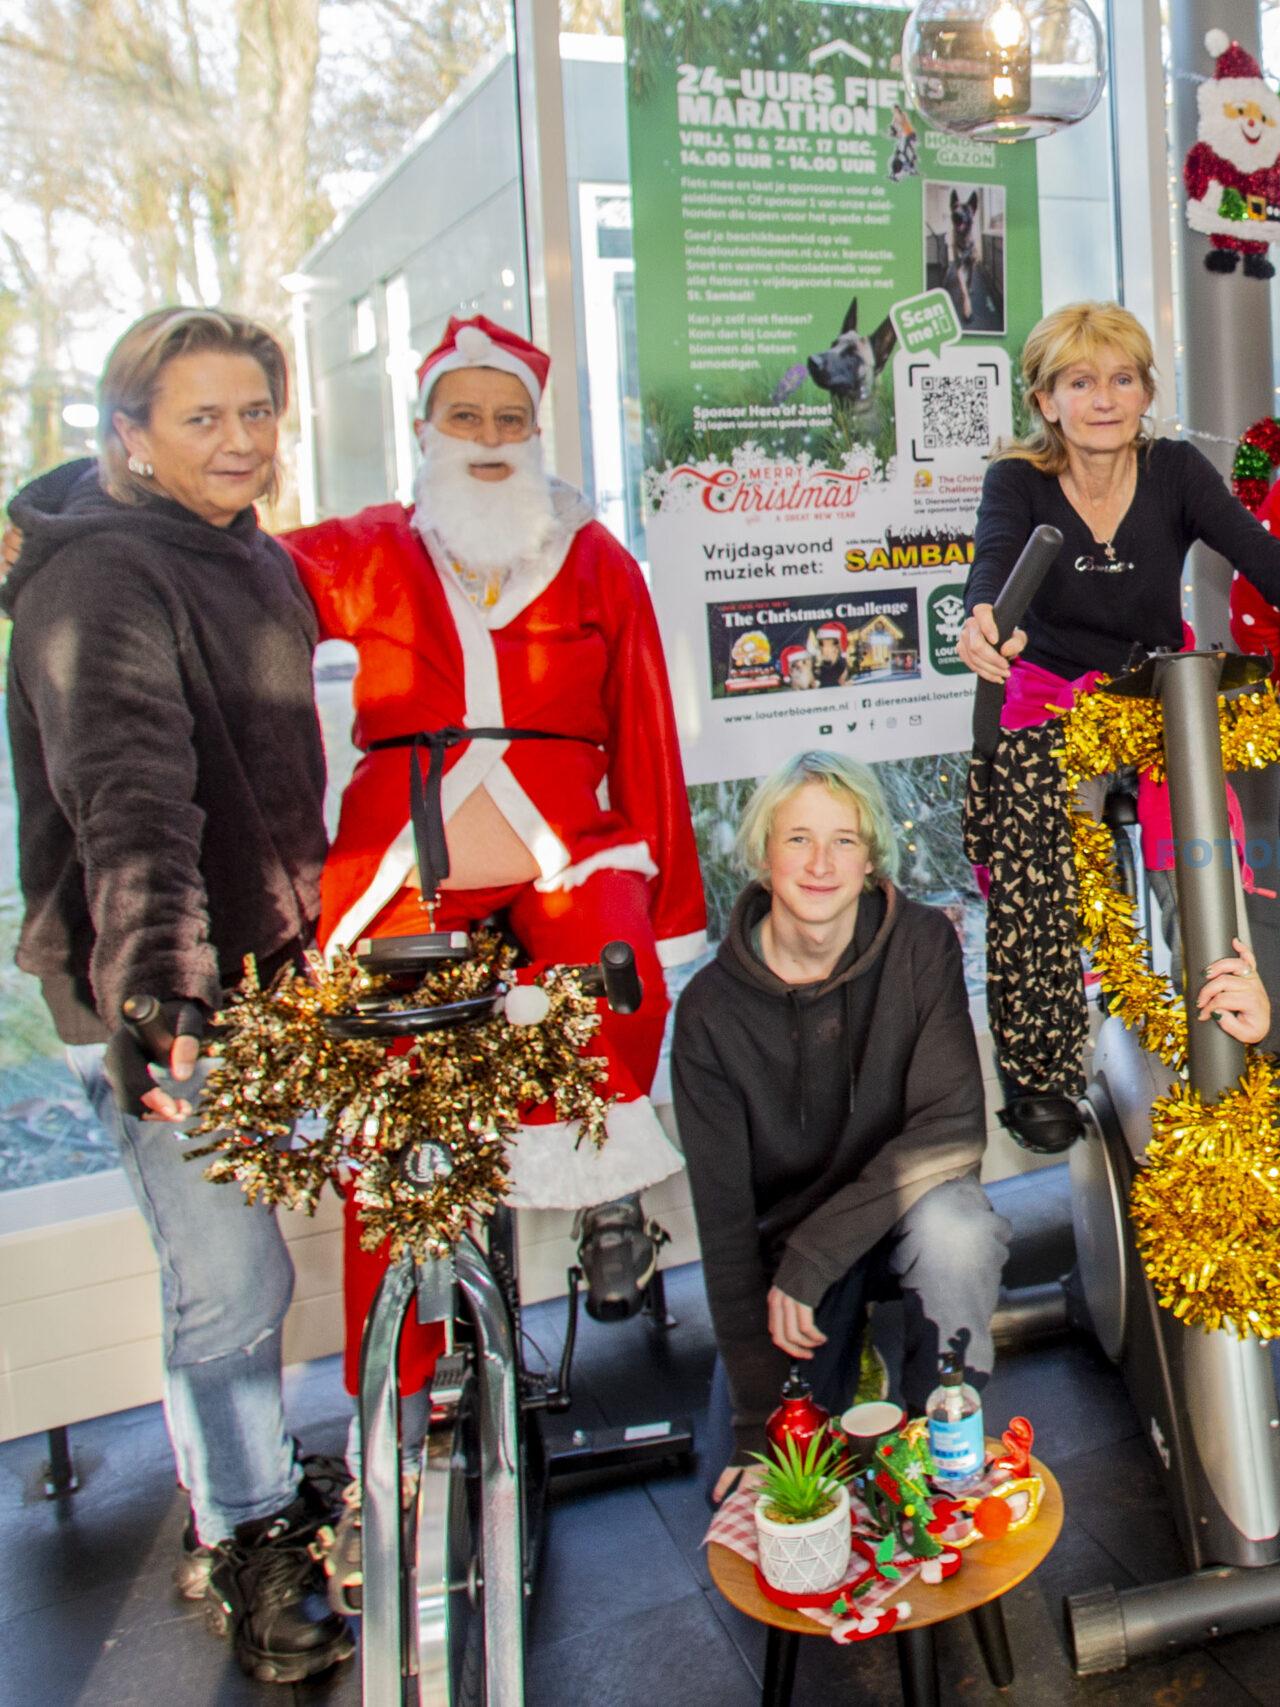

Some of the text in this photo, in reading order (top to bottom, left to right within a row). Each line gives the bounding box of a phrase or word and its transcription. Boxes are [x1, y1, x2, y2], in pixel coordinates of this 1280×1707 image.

[676, 63, 837, 104] 24-UURS
[677, 95, 877, 136] MARATHON
[679, 130, 729, 149] VRIJ.
[733, 133, 752, 149] 16
[774, 136, 812, 153] ZAT.
[815, 138, 833, 154] 17
[836, 139, 877, 157] DEC.
[680, 149, 731, 167] 14.00
[735, 152, 772, 169] UUR
[788, 155, 837, 172] 14.00
[841, 157, 877, 174] UUR
[939, 150, 993, 165] GAZON
[680, 176, 885, 196] Fiets mee en laat je sponsoren voor de
[746, 194, 762, 206] Of
[765, 197, 807, 209] sponsor
[819, 200, 837, 209] van
[839, 200, 865, 210] onze
[682, 207, 725, 219] honden
[728, 208, 746, 220] die
[747, 209, 779, 222] lopen
[781, 212, 806, 223] voor
[809, 211, 826, 223] het
[829, 213, 861, 226] goede
[684, 228, 711, 241] Geef
[714, 231, 724, 244] je
[726, 231, 815, 245] beschikbaarheid
[817, 234, 832, 246] op
[718, 262, 733, 272] en
[735, 262, 773, 272] warme
[775, 261, 855, 274] chocolademelk
[858, 264, 882, 275] voor
[687, 275, 707, 287] alle
[709, 275, 750, 287] fietsers
[761, 276, 832, 290] vrijdagavond
[833, 277, 871, 288] muziek
[873, 278, 894, 289] met
[688, 313, 813, 327] Kan je zelf niet fietsen?
[901, 303, 944, 328] Scan
[688, 328, 715, 339] Kom
[717, 328, 739, 339] dan
[740, 328, 755, 341] bij
[907, 319, 940, 346] me!
[688, 343, 797, 354] bloemen de fietsers
[693, 403, 833, 420] Sponsor Hero of Jane!
[708, 419, 736, 430] lopen
[736, 420, 759, 429] voor
[760, 420, 778, 429] ons
[778, 419, 807, 430] goede
[750, 466, 804, 481] MERRY
[938, 475, 955, 484] The
[671, 466, 870, 514] Christmas
[703, 537, 834, 563] Vrijdagavond
[704, 561, 824, 582] muziek met:
[721, 600, 909, 628] The Christmas Challenge
[723, 701, 849, 723] www.louterbloemen.nl
